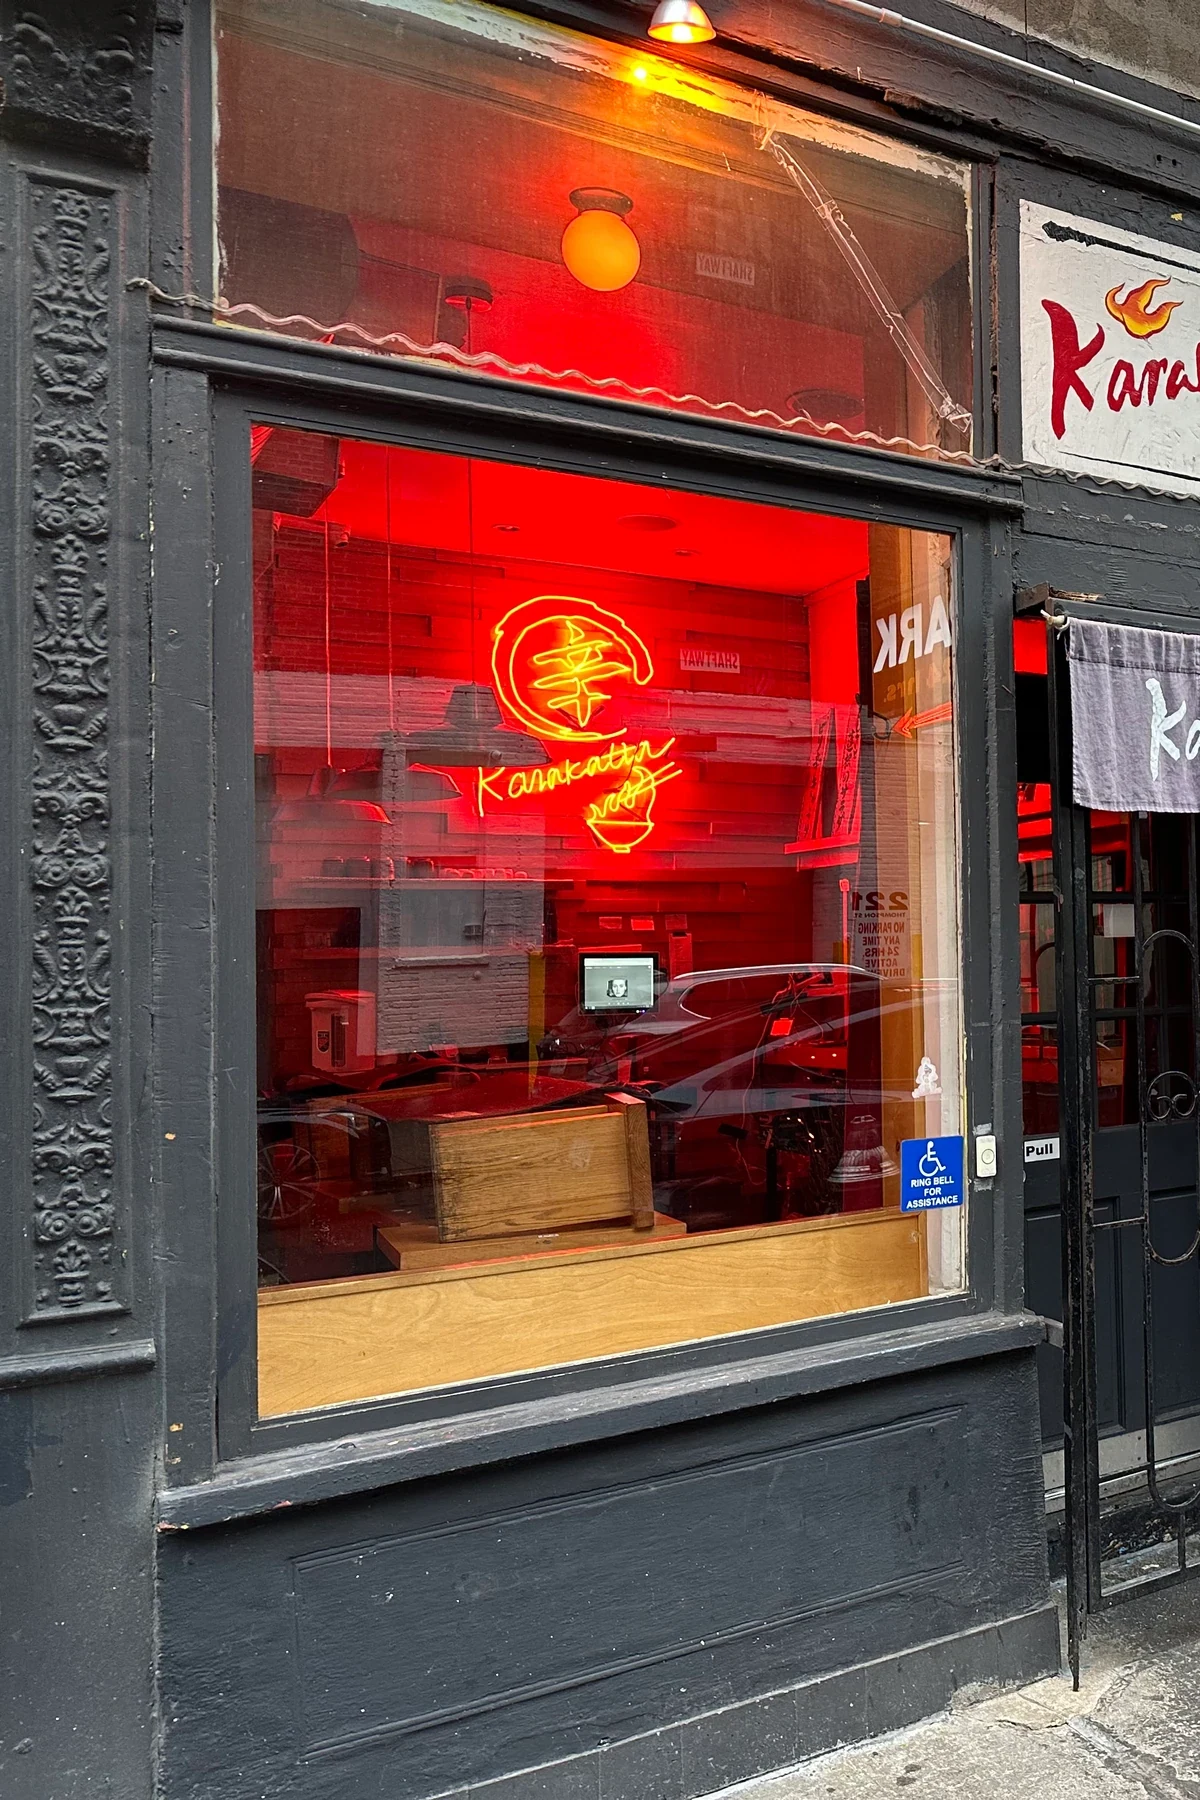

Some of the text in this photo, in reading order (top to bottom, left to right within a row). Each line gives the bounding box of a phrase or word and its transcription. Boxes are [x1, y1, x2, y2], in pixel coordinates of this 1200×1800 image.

[1025, 1143, 1053, 1157] Pull
[910, 1175, 954, 1188] RING BELL
[924, 1187, 941, 1197] FOR
[906, 1195, 958, 1209] ASSISTANCE
